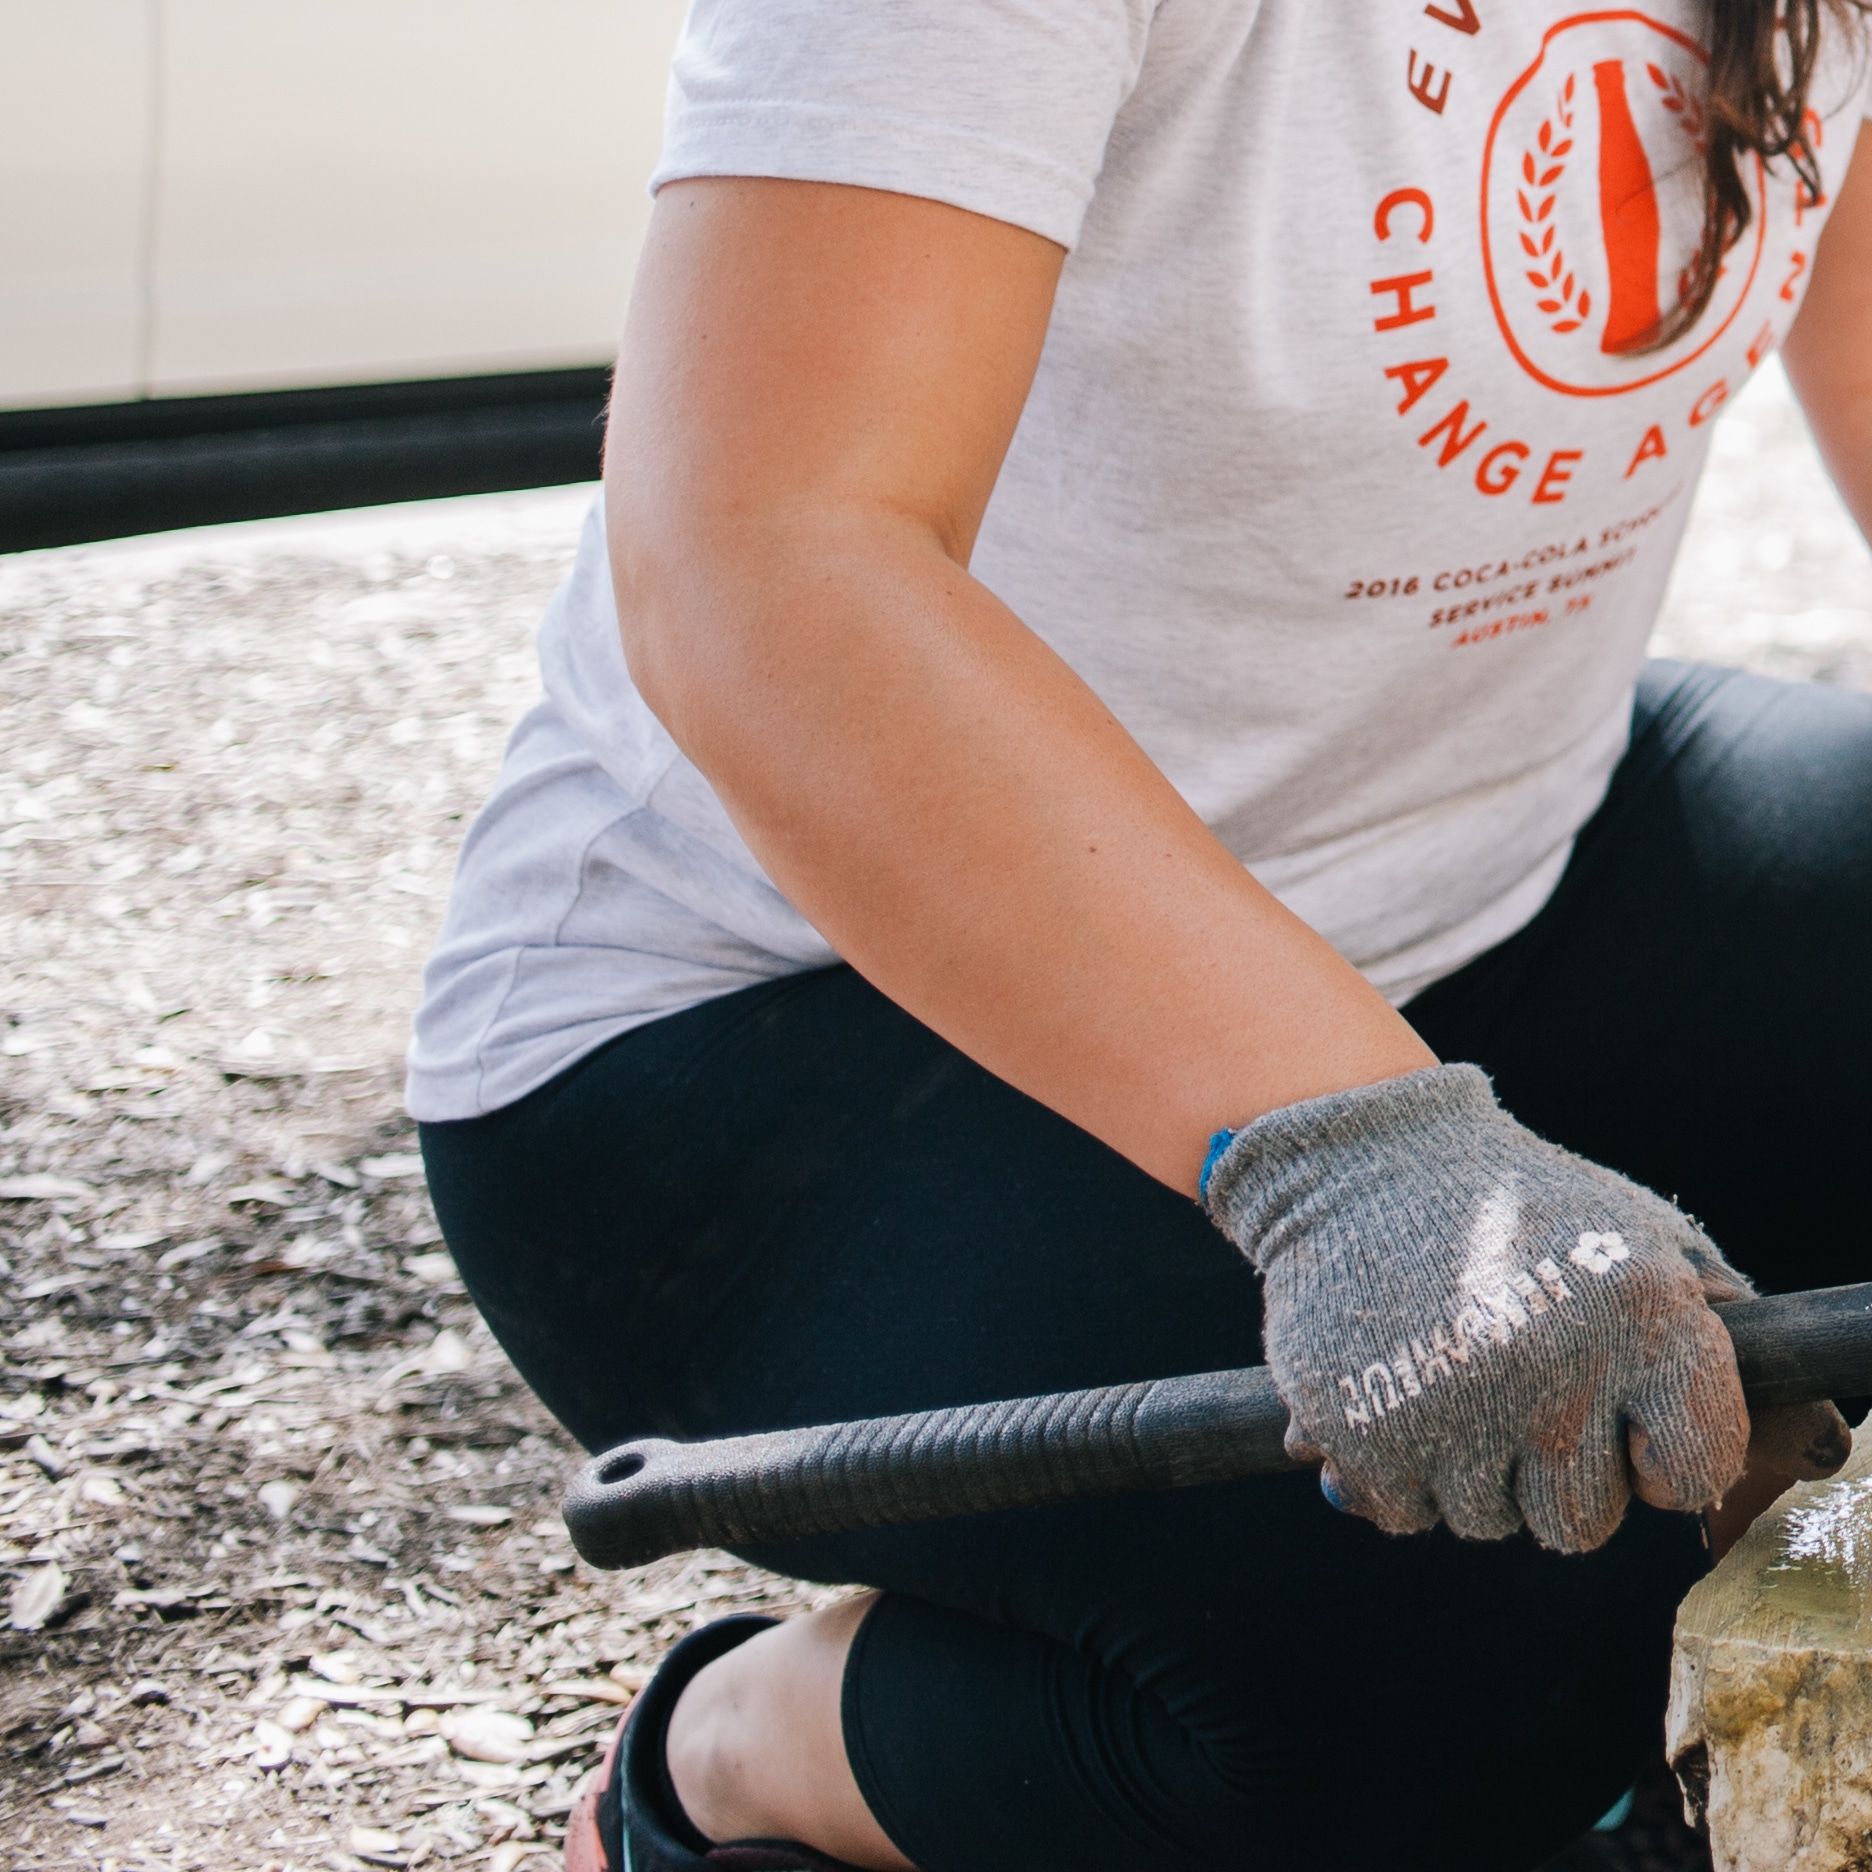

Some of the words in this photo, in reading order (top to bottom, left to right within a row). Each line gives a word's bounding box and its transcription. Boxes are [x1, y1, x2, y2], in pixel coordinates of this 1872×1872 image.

[1368, 186, 1584, 505] CHANGE
[1344, 576, 1420, 601] 2016
[1428, 580, 1539, 629] SERVICE
